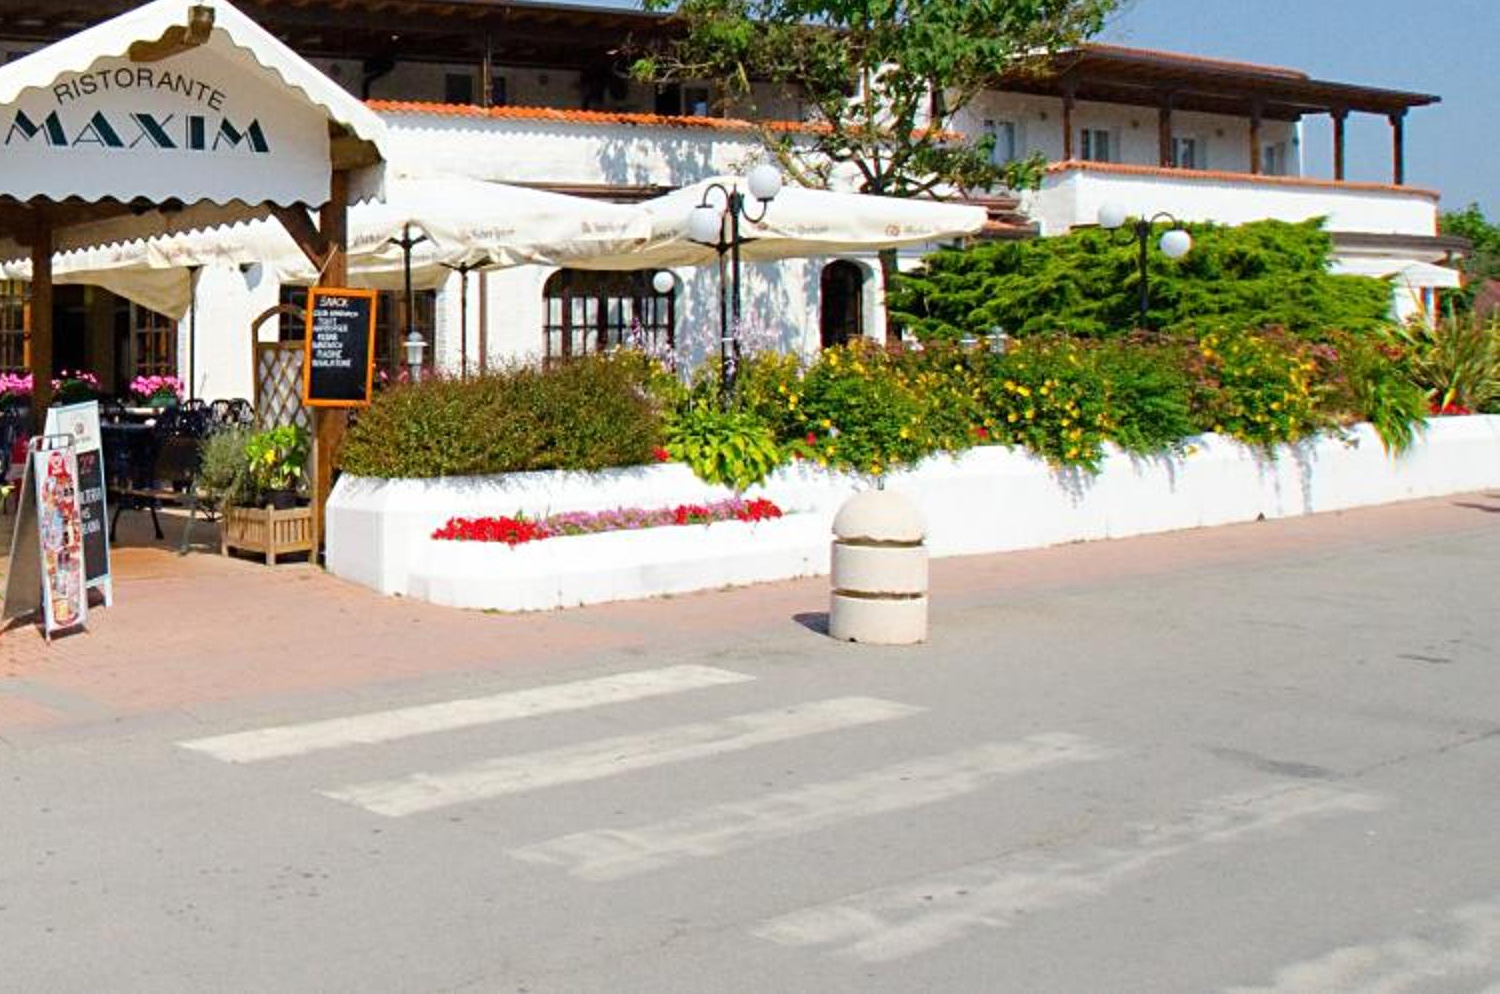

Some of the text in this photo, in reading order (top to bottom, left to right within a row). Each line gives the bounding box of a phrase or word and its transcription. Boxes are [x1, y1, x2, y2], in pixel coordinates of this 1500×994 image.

[53, 66, 227, 111] RISTORANTE
[4, 108, 269, 153] MAXIM
[319, 296, 348, 307] SNACK
